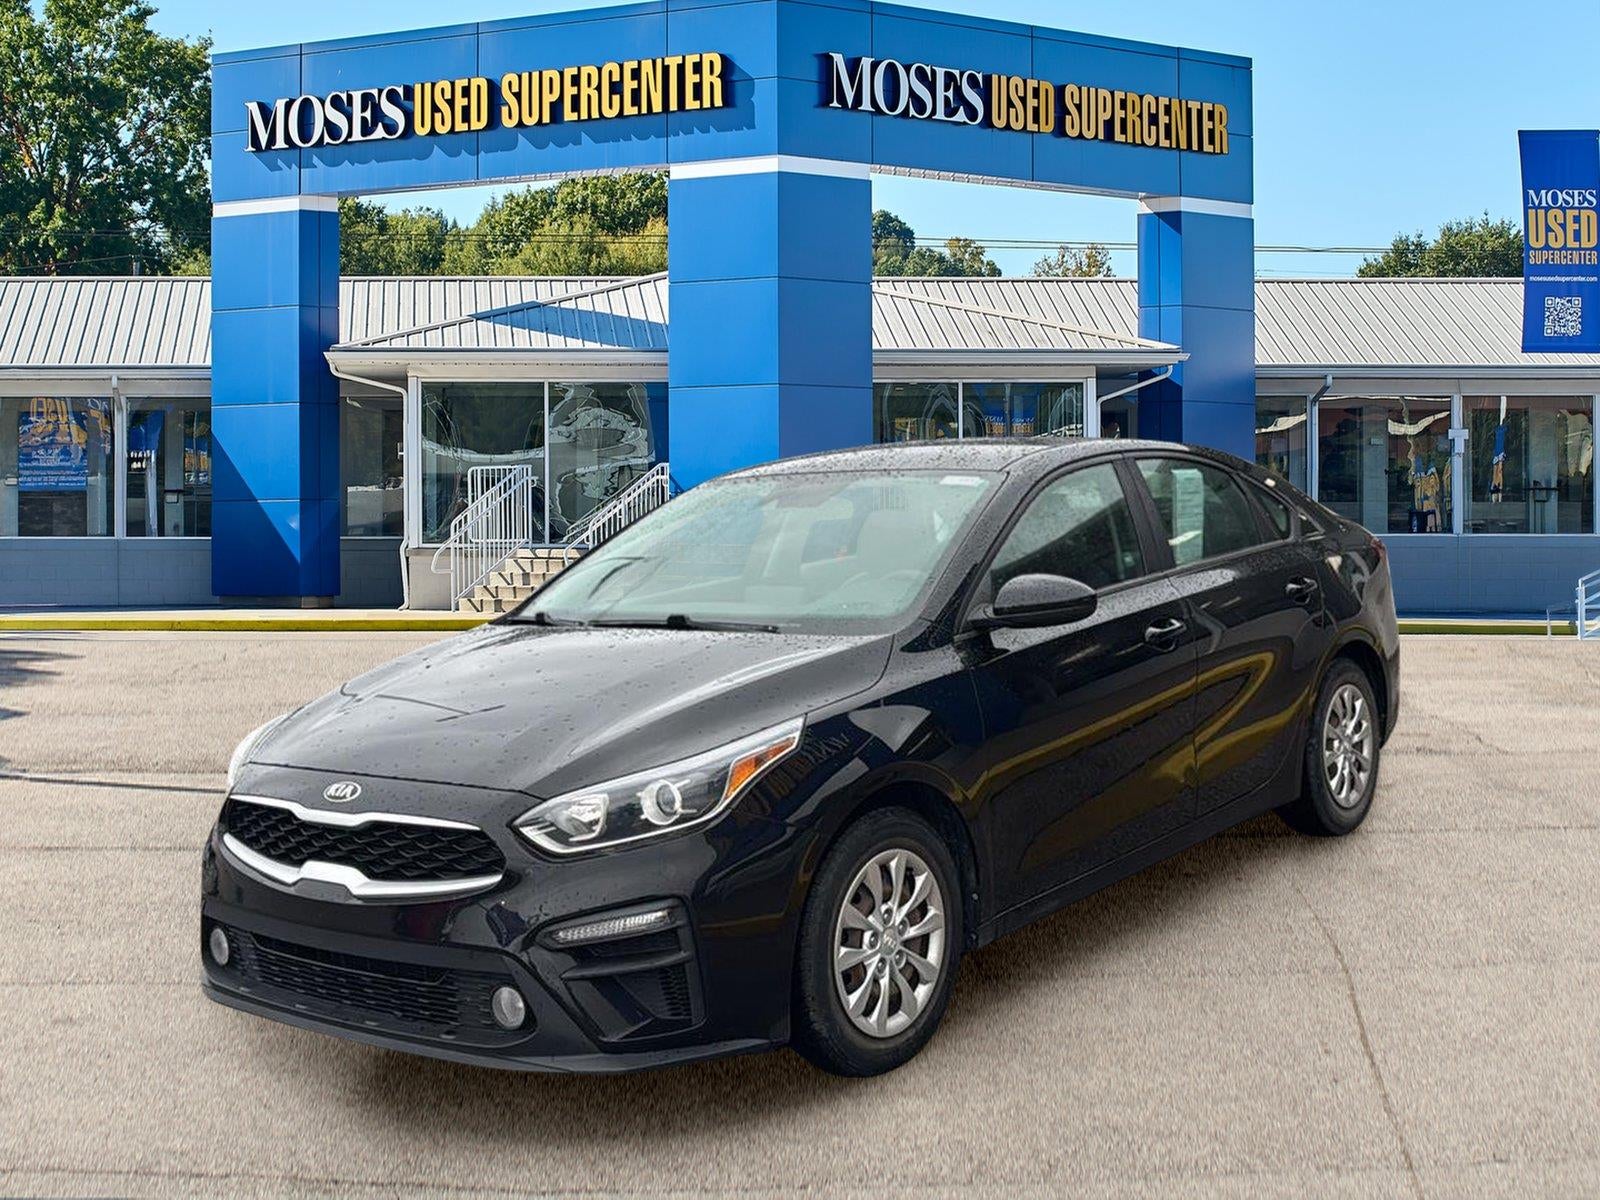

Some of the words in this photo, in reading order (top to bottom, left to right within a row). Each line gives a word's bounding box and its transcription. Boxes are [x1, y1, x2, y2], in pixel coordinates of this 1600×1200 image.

[244, 85, 406, 152] MOSES
[413, 77, 488, 136] USED
[500, 52, 724, 128] SUPERCENTER
[828, 52, 985, 125] MOSES
[991, 74, 1055, 133] USED
[1064, 83, 1229, 154] SUPERCENTER
[1527, 189, 1597, 207] MOSES
[1528, 209, 1598, 249] USED
[1529, 250, 1598, 265] SUPERCENTER
[1529, 275, 1598, 283] mosesusedsupercenter.com
[326, 783, 356, 799] KIA
